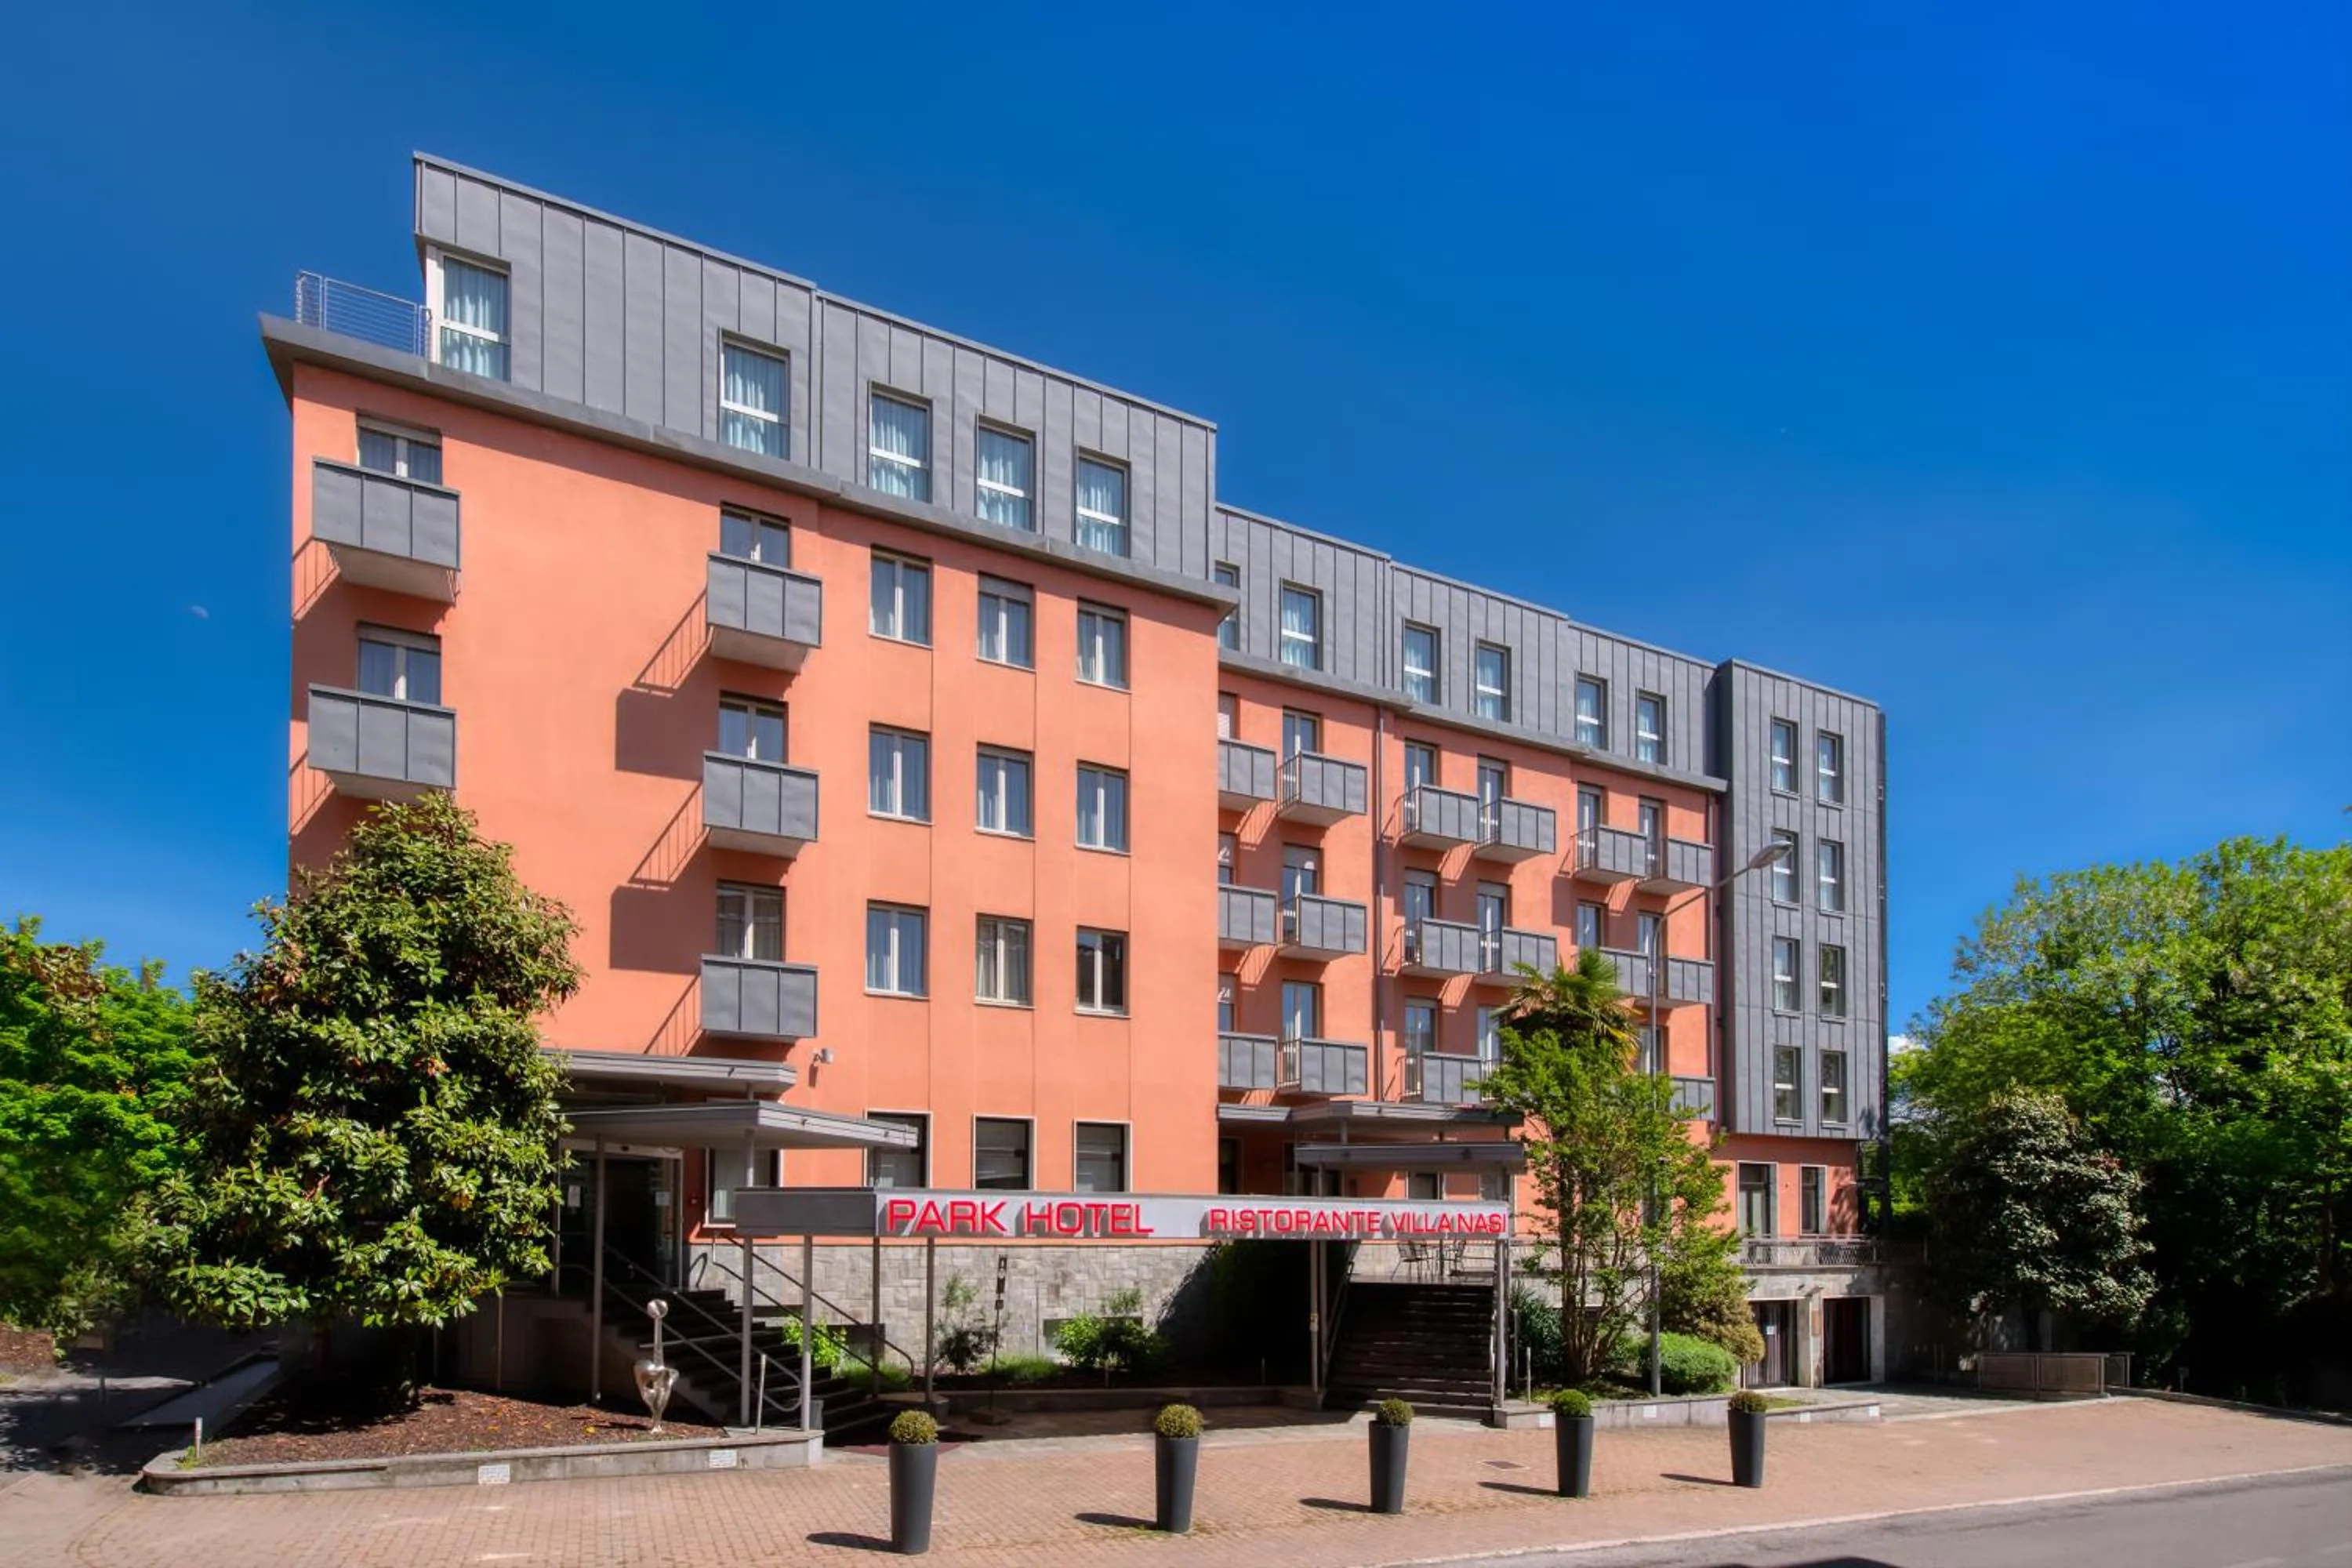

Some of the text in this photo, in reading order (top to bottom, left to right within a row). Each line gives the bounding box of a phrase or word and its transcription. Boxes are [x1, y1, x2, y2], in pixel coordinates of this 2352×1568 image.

[887, 1198, 1155, 1235] PARK HOTEL
[1208, 1208, 1381, 1233] RISTORANTE
